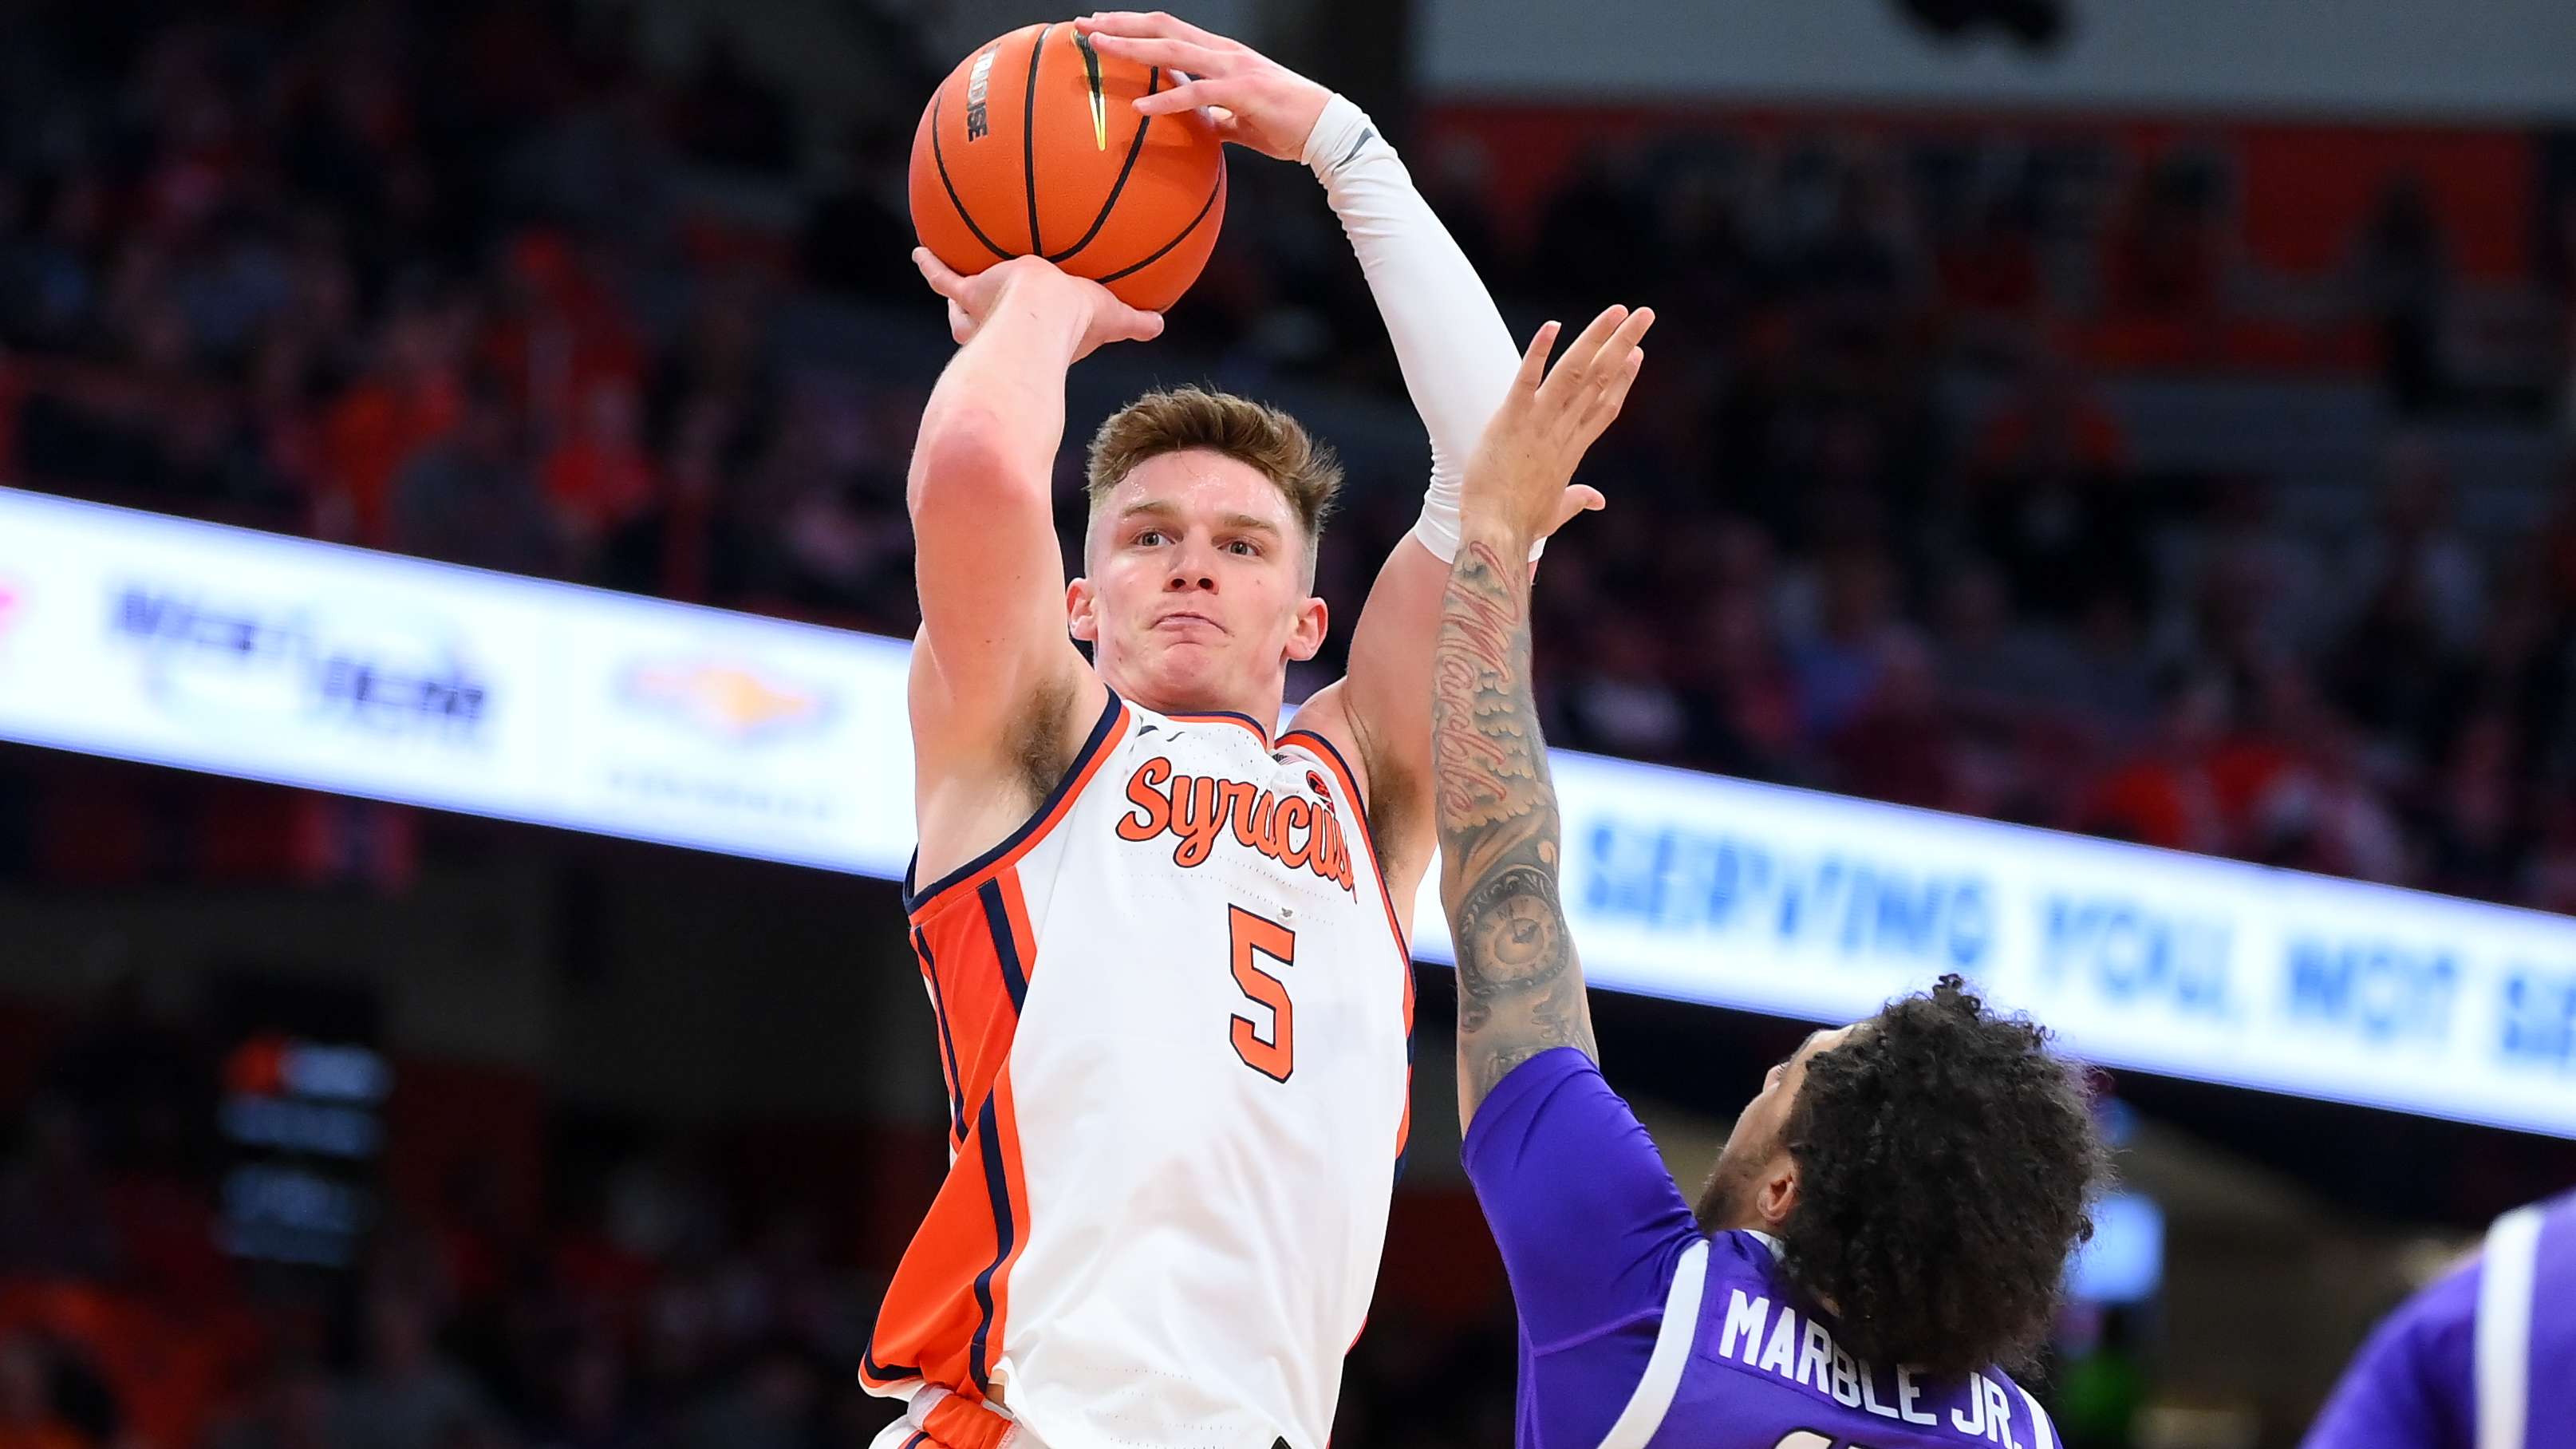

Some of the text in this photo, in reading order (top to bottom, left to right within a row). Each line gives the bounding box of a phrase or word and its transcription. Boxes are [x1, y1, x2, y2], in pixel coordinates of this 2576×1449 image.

[1115, 756, 1357, 904] Syracus
[1228, 902, 1296, 1084] 5
[1719, 1289, 1938, 1426] MARBLE
